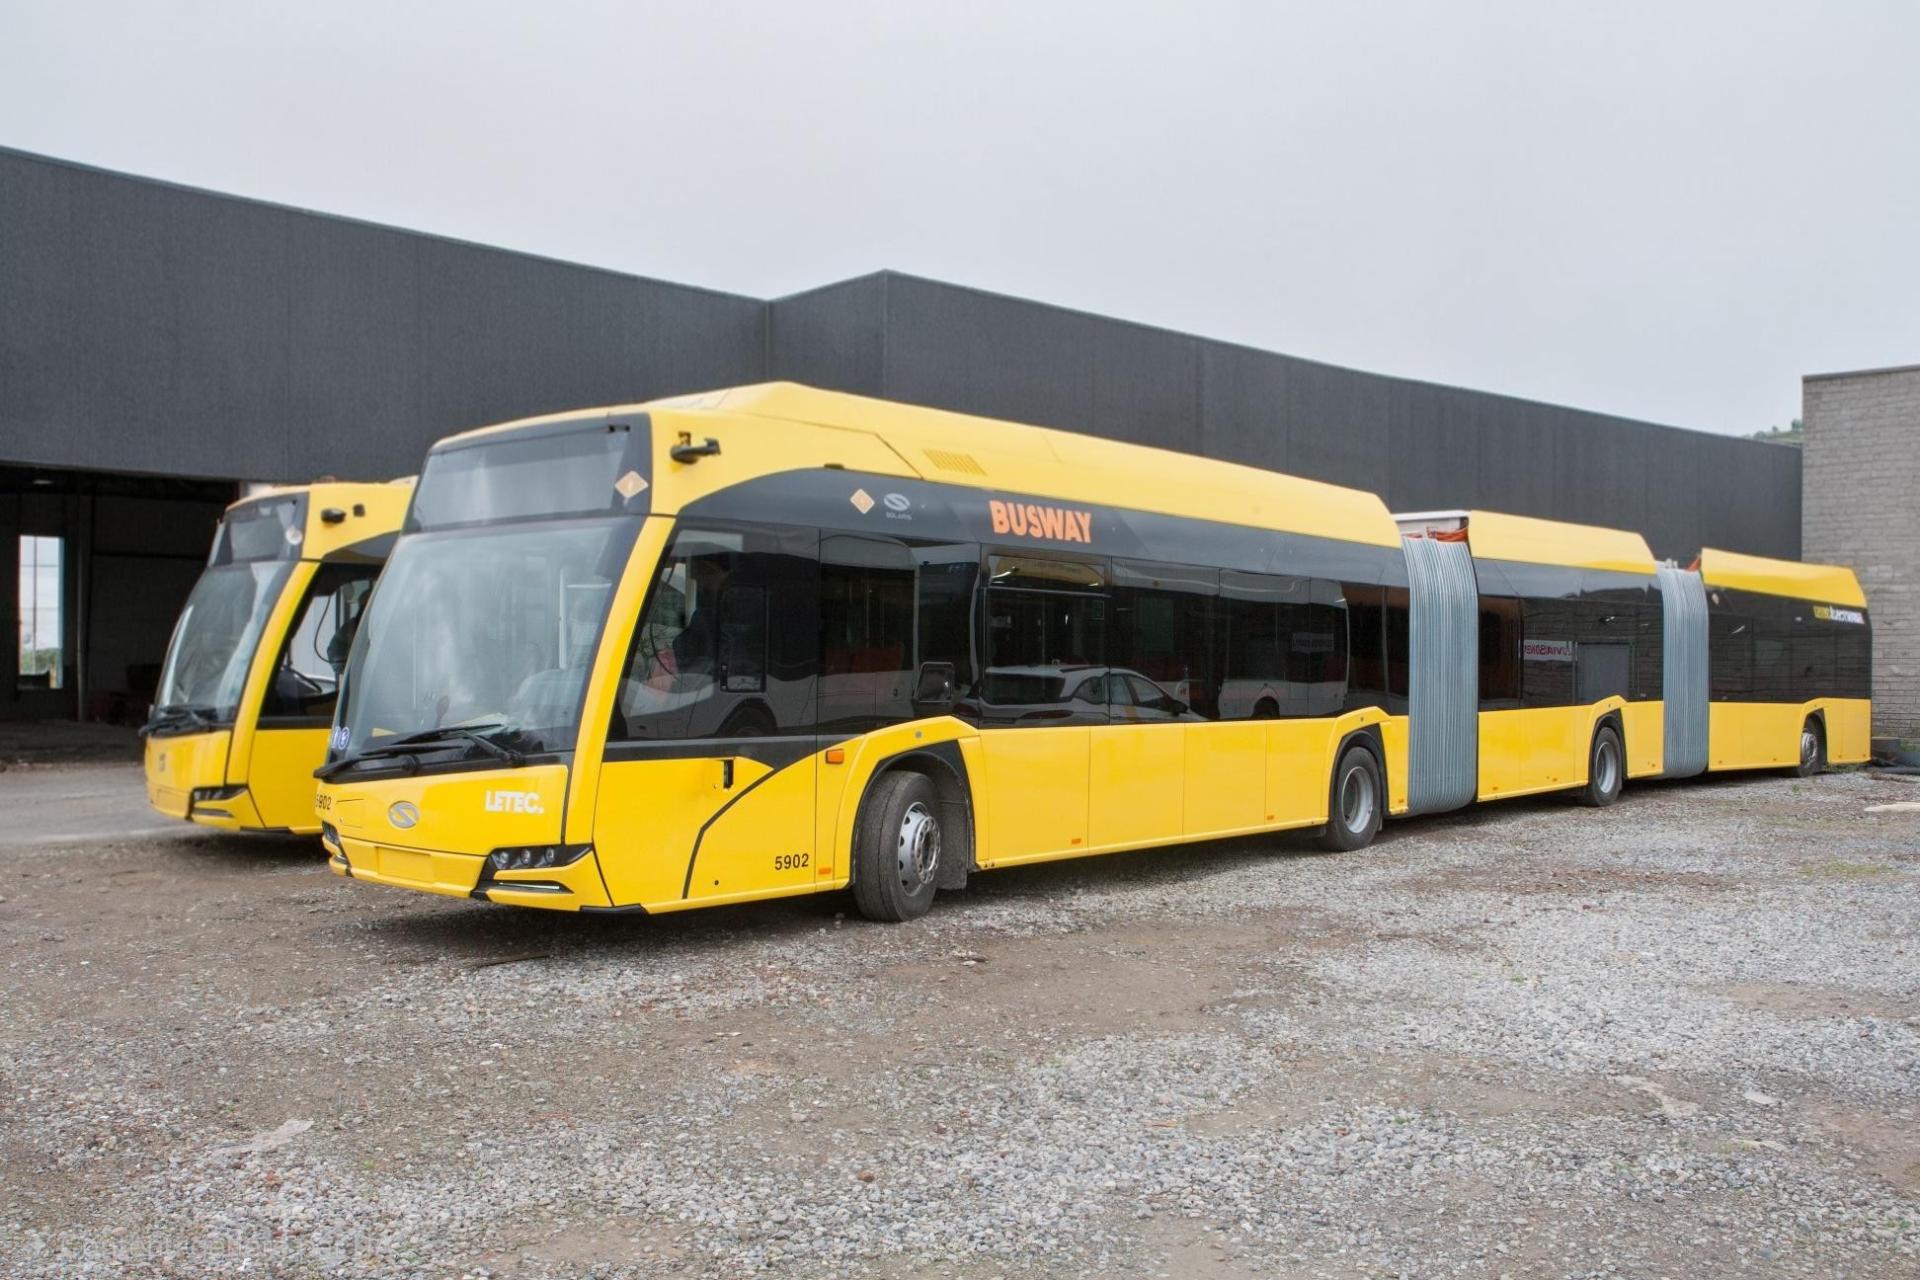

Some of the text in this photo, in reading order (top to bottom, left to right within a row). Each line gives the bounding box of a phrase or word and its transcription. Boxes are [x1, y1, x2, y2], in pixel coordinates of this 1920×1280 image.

[989, 500, 1092, 543] BUSWAY
[485, 790, 544, 814] LETEC.
[775, 853, 809, 870] 5902
